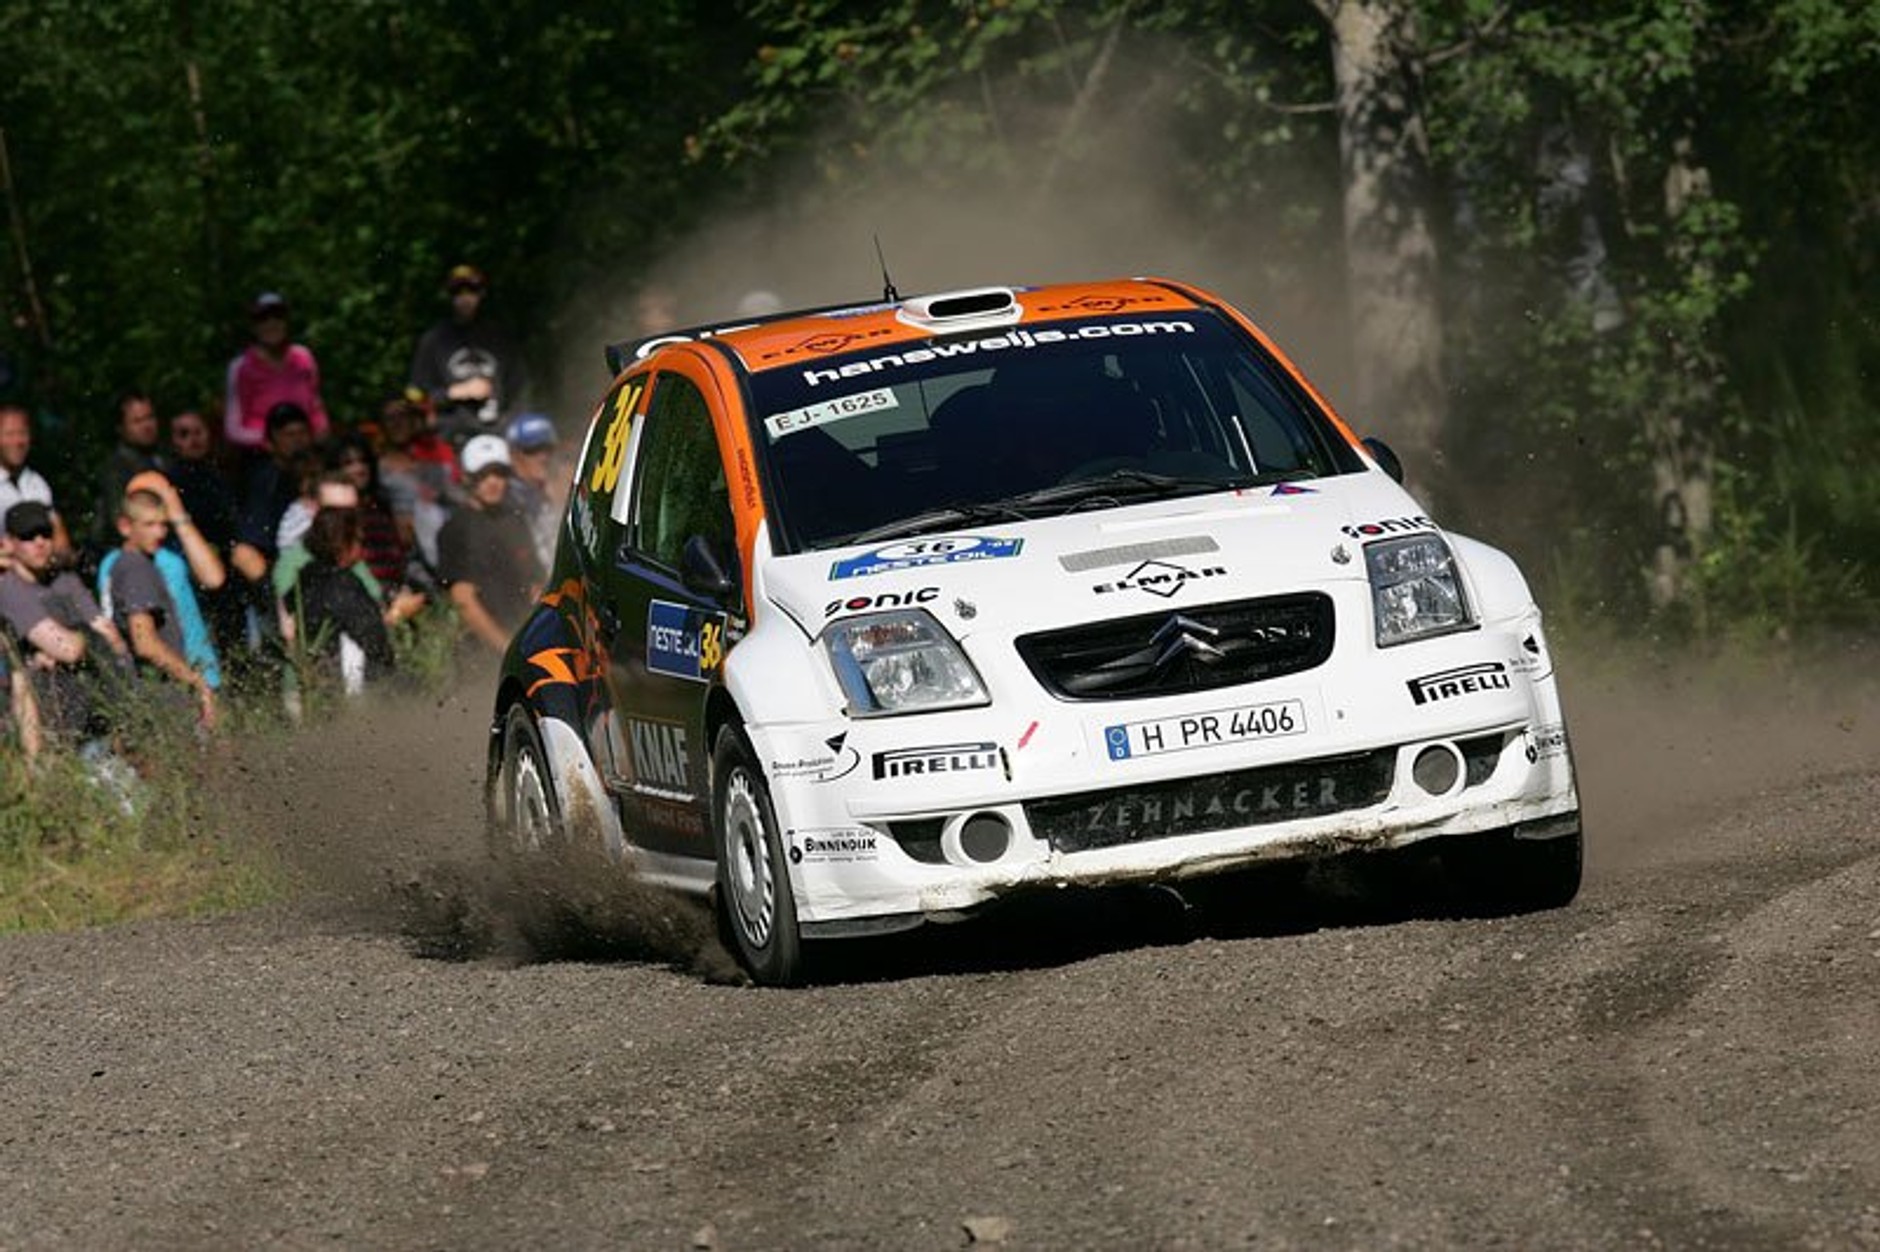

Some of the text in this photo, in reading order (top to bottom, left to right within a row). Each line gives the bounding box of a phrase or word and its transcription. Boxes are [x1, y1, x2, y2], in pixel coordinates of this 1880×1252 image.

[803, 321, 1195, 387] hansweijs.com
[591, 384, 643, 493] 36
[903, 540, 955, 554] 36
[1092, 566, 1228, 595] ELMAR
[700, 622, 721, 670] 36
[1406, 662, 1511, 706] PIRELLI
[1142, 706, 1295, 751] H PR 4406
[872, 742, 997, 781] PIRELLI
[1115, 747, 1125, 758] D
[1087, 776, 1339, 831] ZEHNACKER
